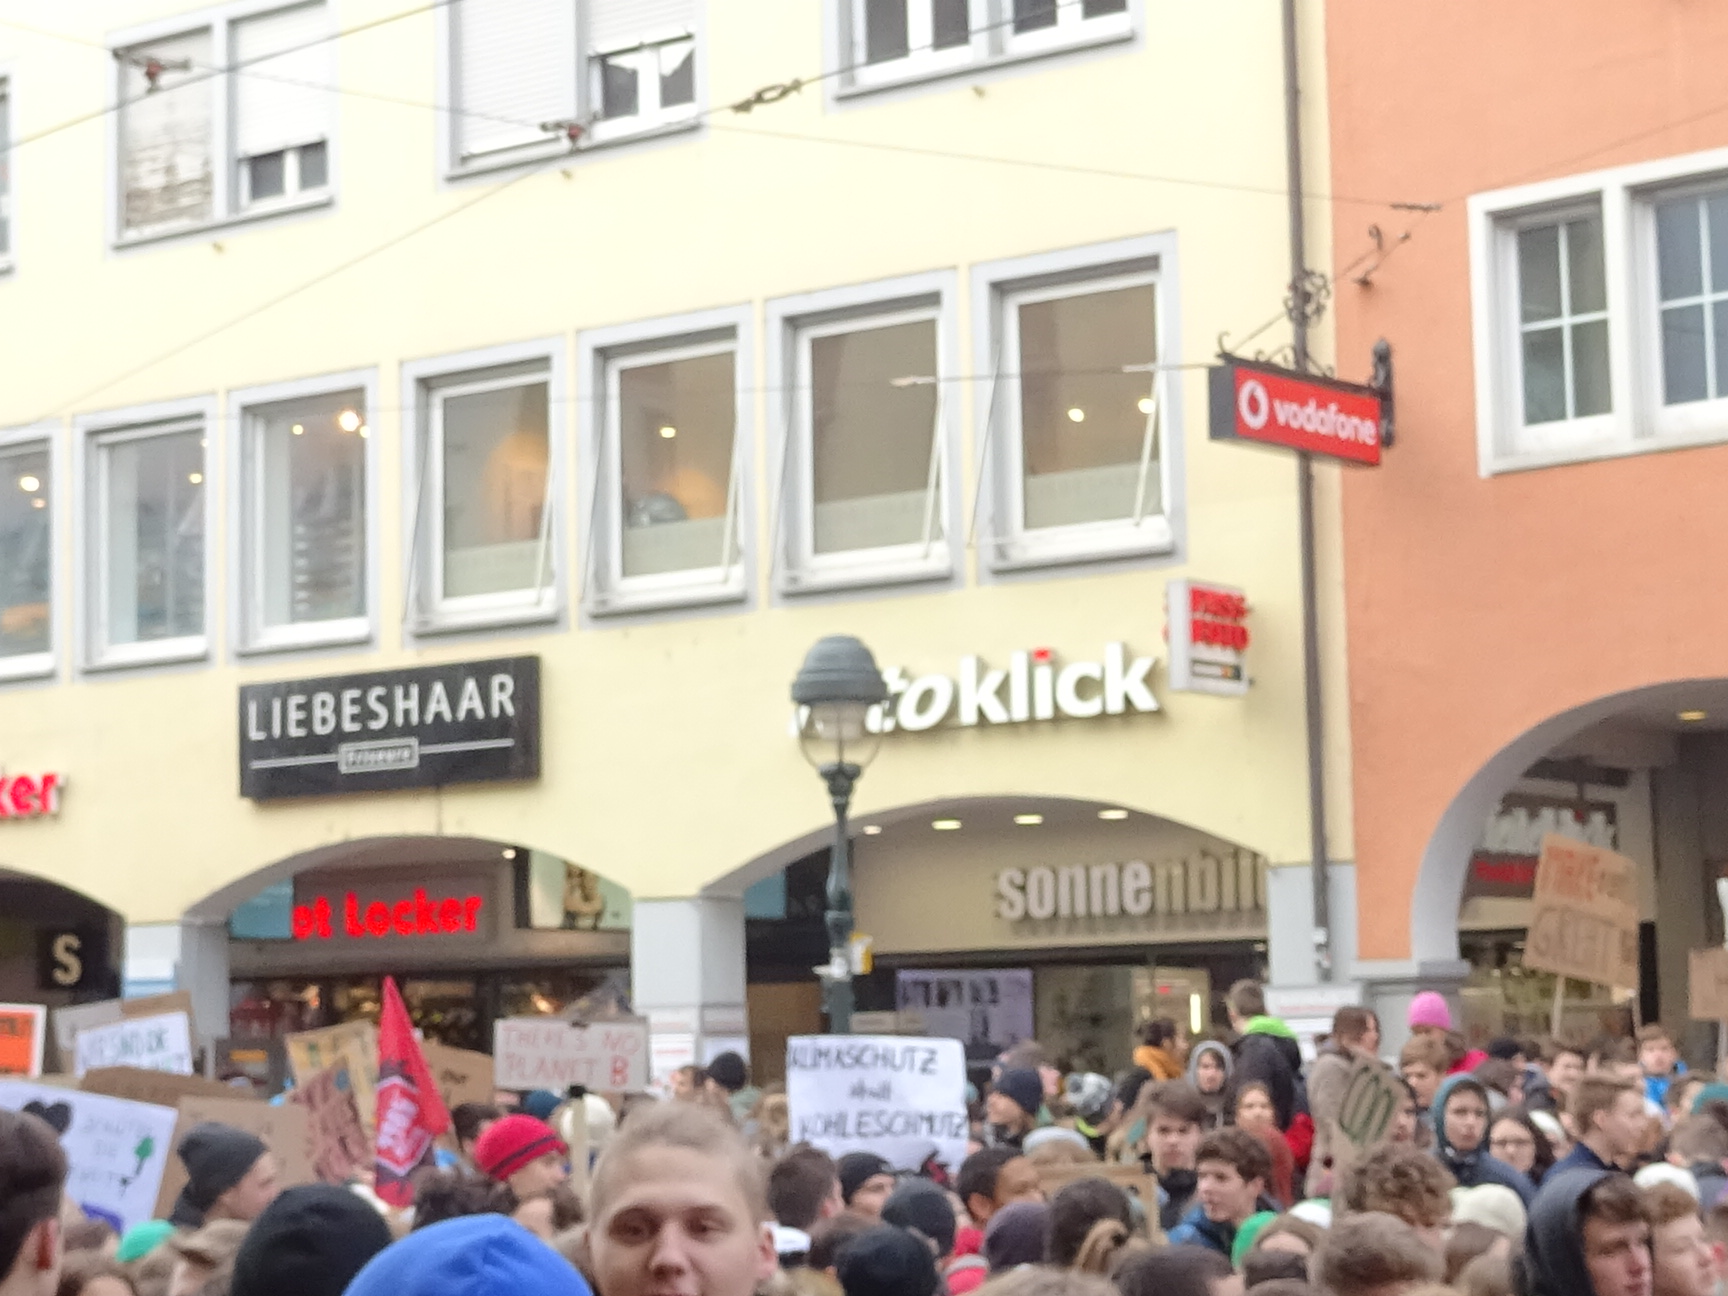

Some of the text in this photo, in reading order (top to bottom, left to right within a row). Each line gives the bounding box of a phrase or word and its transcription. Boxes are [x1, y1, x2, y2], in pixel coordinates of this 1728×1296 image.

[1273, 398, 1377, 446] vodafone
[246, 672, 517, 742] LIEBESHAAR
[344, 886, 484, 939] Locker
[51, 932, 84, 986] S
[603, 1032, 641, 1056] NO
[610, 1055, 630, 1087] B
